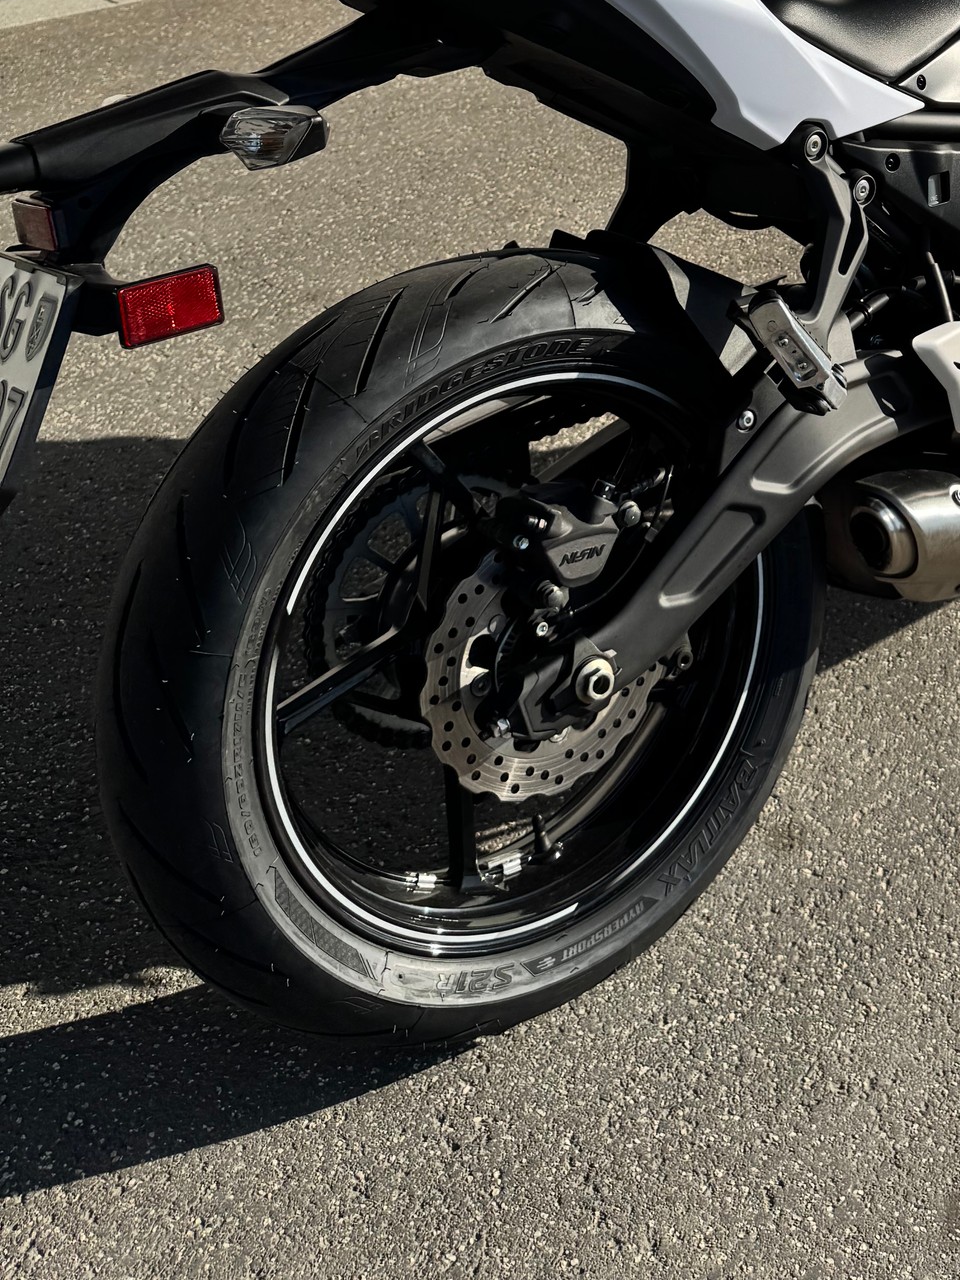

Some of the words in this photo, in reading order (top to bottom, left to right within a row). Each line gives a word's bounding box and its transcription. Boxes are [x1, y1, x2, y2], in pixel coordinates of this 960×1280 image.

[356, 337, 595, 464] BRIDGESTONE
[656, 759, 757, 897] BATTLAX
[435, 962, 516, 994] S21R
[560, 900, 645, 962] HYPERSPORT
